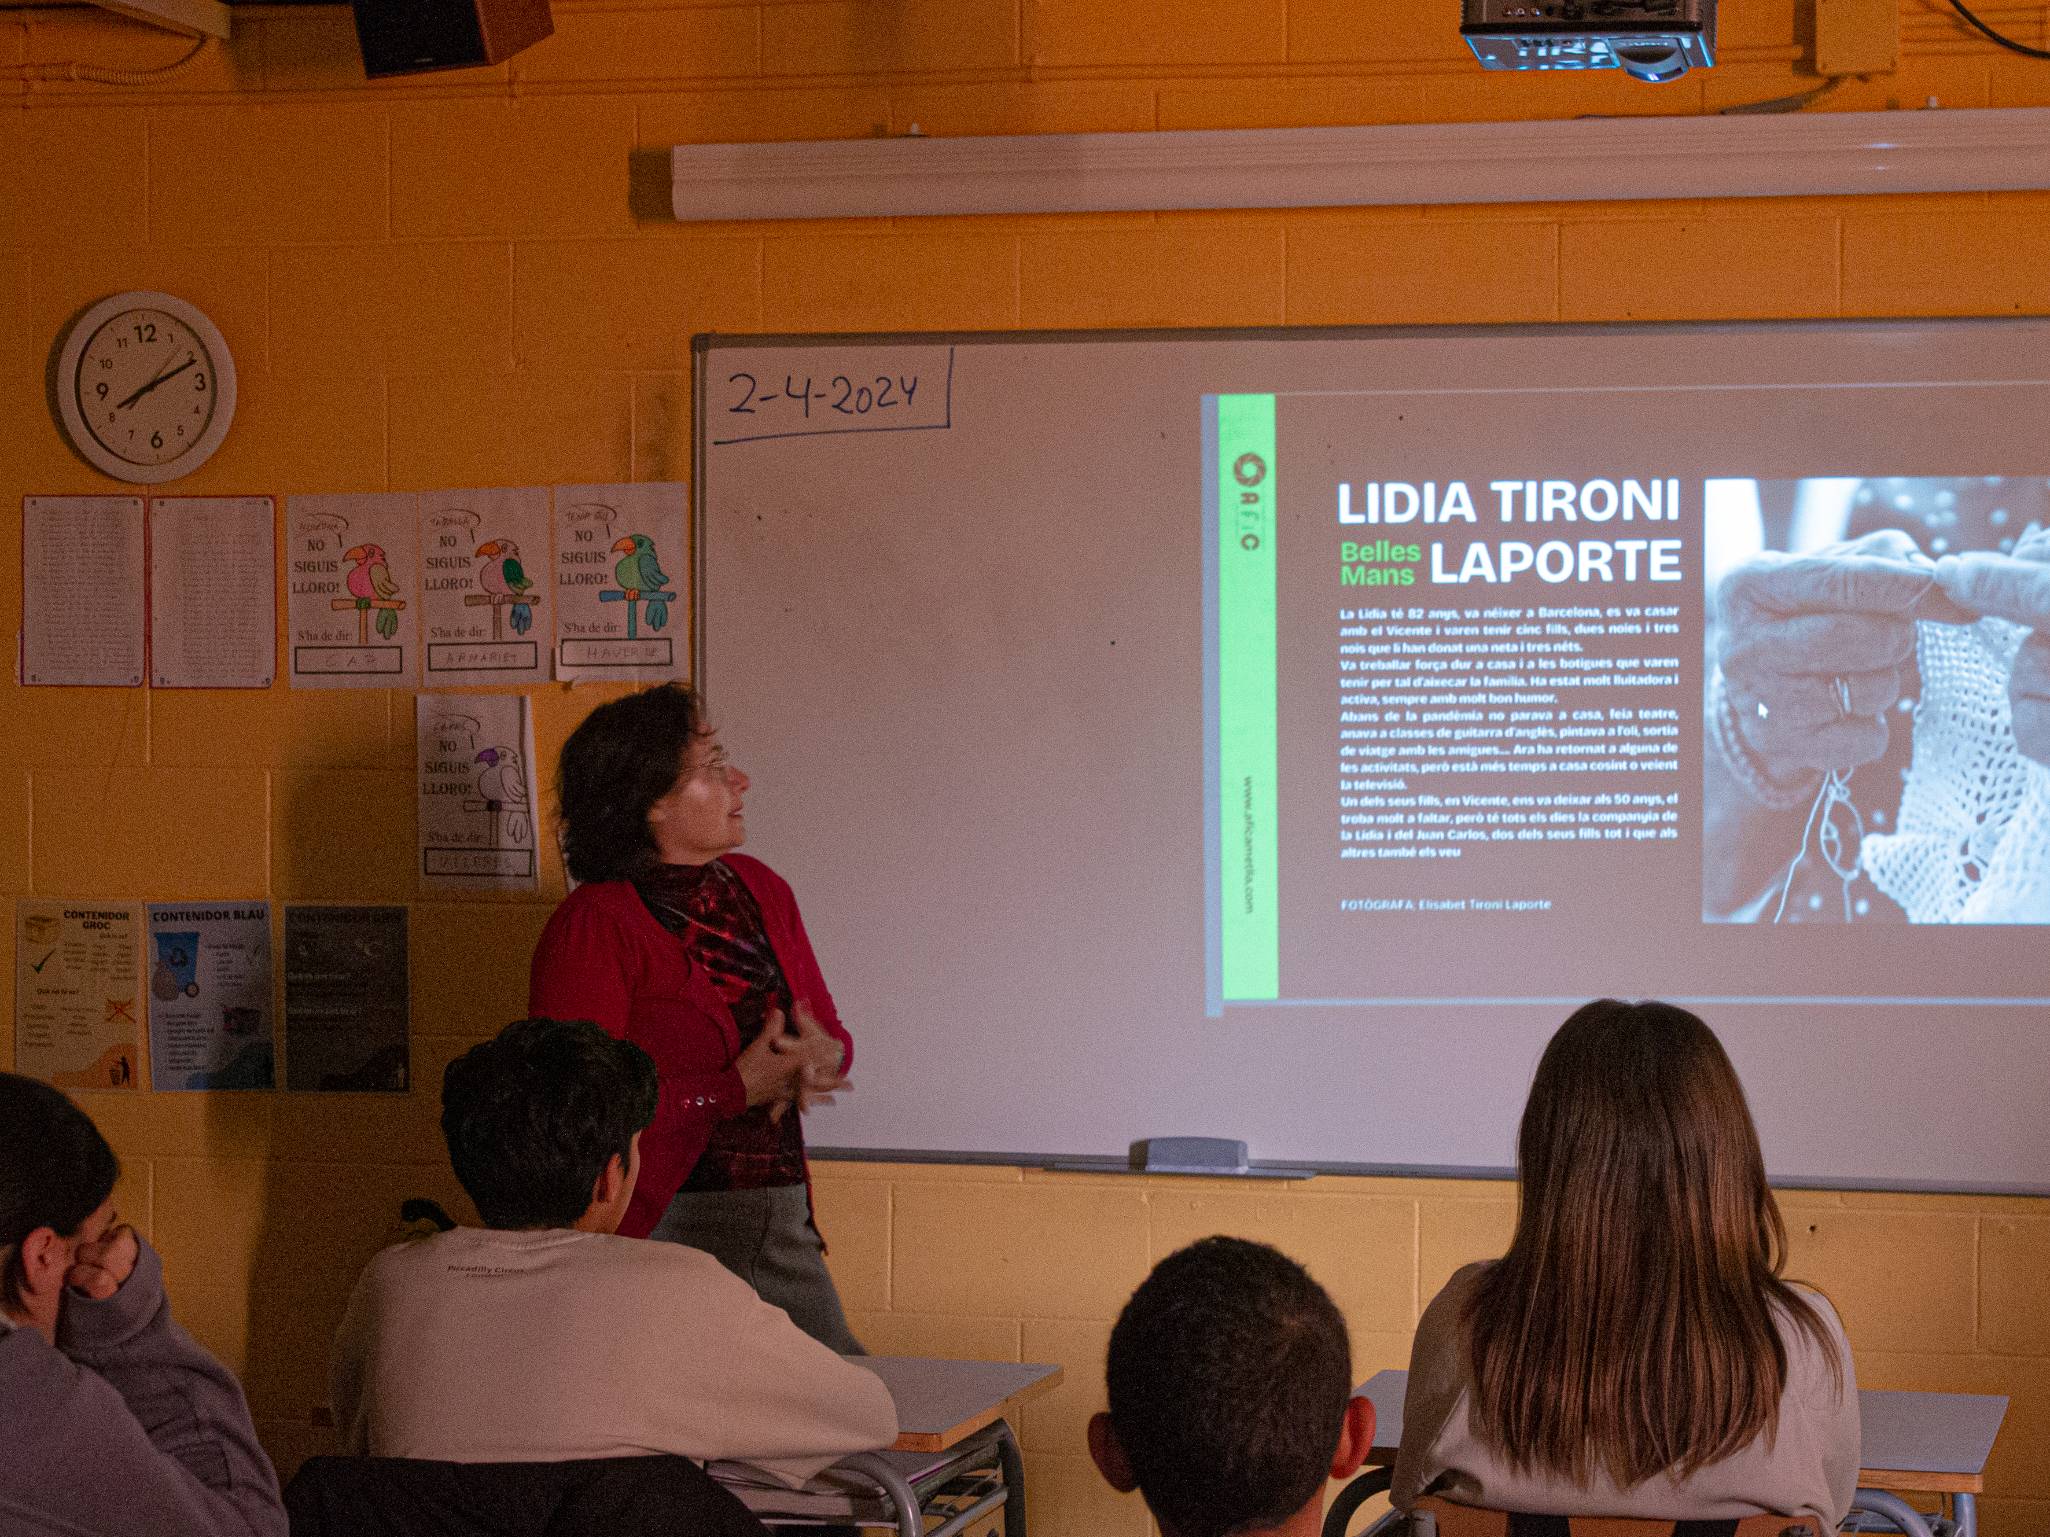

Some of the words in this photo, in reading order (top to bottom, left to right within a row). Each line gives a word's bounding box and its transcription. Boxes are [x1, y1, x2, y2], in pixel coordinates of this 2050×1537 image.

[134, 324, 156, 342] 12
[168, 334, 174, 342] 1
[117, 338, 128, 348] 11
[100, 359, 112, 369] 10
[194, 373, 206, 392] 3
[96, 382, 108, 400] 9
[729, 373, 917, 418] 2-4-2024
[194, 405, 200, 414] 4
[108, 412, 116, 422] 8
[128, 430, 134, 440] 7
[177, 426, 184, 436] 5
[150, 431, 163, 448] 6
[1338, 481, 1477, 524] LIDIA
[1490, 478, 1680, 522] TIRONI
[439, 536, 456, 548] NO
[574, 530, 592, 542] NO
[307, 539, 325, 551] NO
[561, 551, 606, 564] SIGUIS
[1341, 540, 1421, 563] Belles
[294, 561, 338, 572] SIGUIS
[426, 556, 471, 569] SIGUIS
[1431, 539, 1682, 583] LAPORTE
[559, 573, 608, 586] LLORO!
[1341, 565, 1415, 586] Mans
[292, 582, 340, 594] LLORO!
[425, 578, 473, 590] LLORO!
[1340, 609, 1355, 620] La
[1390, 608, 1404, 619] té
[1408, 608, 1424, 619] 82
[1464, 609, 1480, 619] va
[1606, 608, 1621, 617] es
[1625, 607, 1641, 617] va
[1644, 607, 1679, 617] casar
[454, 626, 466, 638] de
[588, 622, 601, 633] de
[1340, 625, 1368, 636] amb
[1370, 625, 1383, 636] el
[1386, 626, 1432, 636] Vicente
[1444, 626, 1480, 636] varen
[1482, 625, 1512, 635] tenir
[1516, 624, 1542, 635] cinc
[1574, 623, 1605, 634] dues
[1608, 623, 1642, 634] noies
[1654, 623, 1679, 633] tres
[320, 631, 332, 641] de
[1340, 643, 1366, 654] nois
[1367, 644, 1391, 656] que
[1402, 642, 1426, 653] han
[1427, 642, 1463, 653] donat
[1465, 643, 1489, 653] una
[1490, 642, 1519, 653] neta
[1526, 642, 1552, 652] tres
[1340, 660, 1357, 671] Va
[1359, 659, 1412, 670] treballar
[1450, 659, 1472, 670] dur
[1486, 660, 1516, 670] casa
[1538, 658, 1556, 669] les
[1559, 658, 1613, 671] botigues
[1616, 659, 1640, 670] que
[1643, 658, 1679, 668] varen
[1381, 695, 1428, 707] sempre
[1429, 693, 1458, 704] amb
[1458, 693, 1487, 704] molt
[1488, 692, 1513, 704] bon
[1340, 711, 1379, 722] Abans
[1384, 711, 1400, 722] de
[1405, 710, 1418, 722] la
[1488, 712, 1505, 721] no
[1510, 711, 1553, 722] parava
[1609, 708, 1633, 720] feia
[439, 740, 457, 752] NO
[425, 762, 470, 774] SIGUIS
[1340, 780, 1352, 790] la
[1359, 796, 1386, 807] dels
[1387, 797, 1416, 807] seus
[1444, 797, 1460, 806] en
[1512, 796, 1535, 806] ens
[1536, 796, 1552, 806] va
[1553, 794, 1592, 805] deixar
[1594, 793, 1612, 805] als
[1614, 793, 1631, 805] 50
[1666, 793, 1678, 804] el
[1340, 830, 1352, 841] la
[1394, 829, 1414, 840] del
[1416, 829, 1444, 840] Juan
[1491, 829, 1514, 840] dos
[1517, 828, 1544, 840] dels
[1546, 830, 1576, 840] seus
[1578, 827, 1601, 839] fills
[1604, 828, 1622, 839] tot
[1632, 829, 1656, 841] que
[1659, 827, 1678, 838] als
[1340, 847, 1376, 858] altres
[1418, 846, 1437, 858] els
[64, 910, 130, 921] CONTENIDOR
[153, 910, 231, 922] CONTENIDOR
[234, 909, 264, 920] BLAU
[82, 921, 110, 930] GROC
